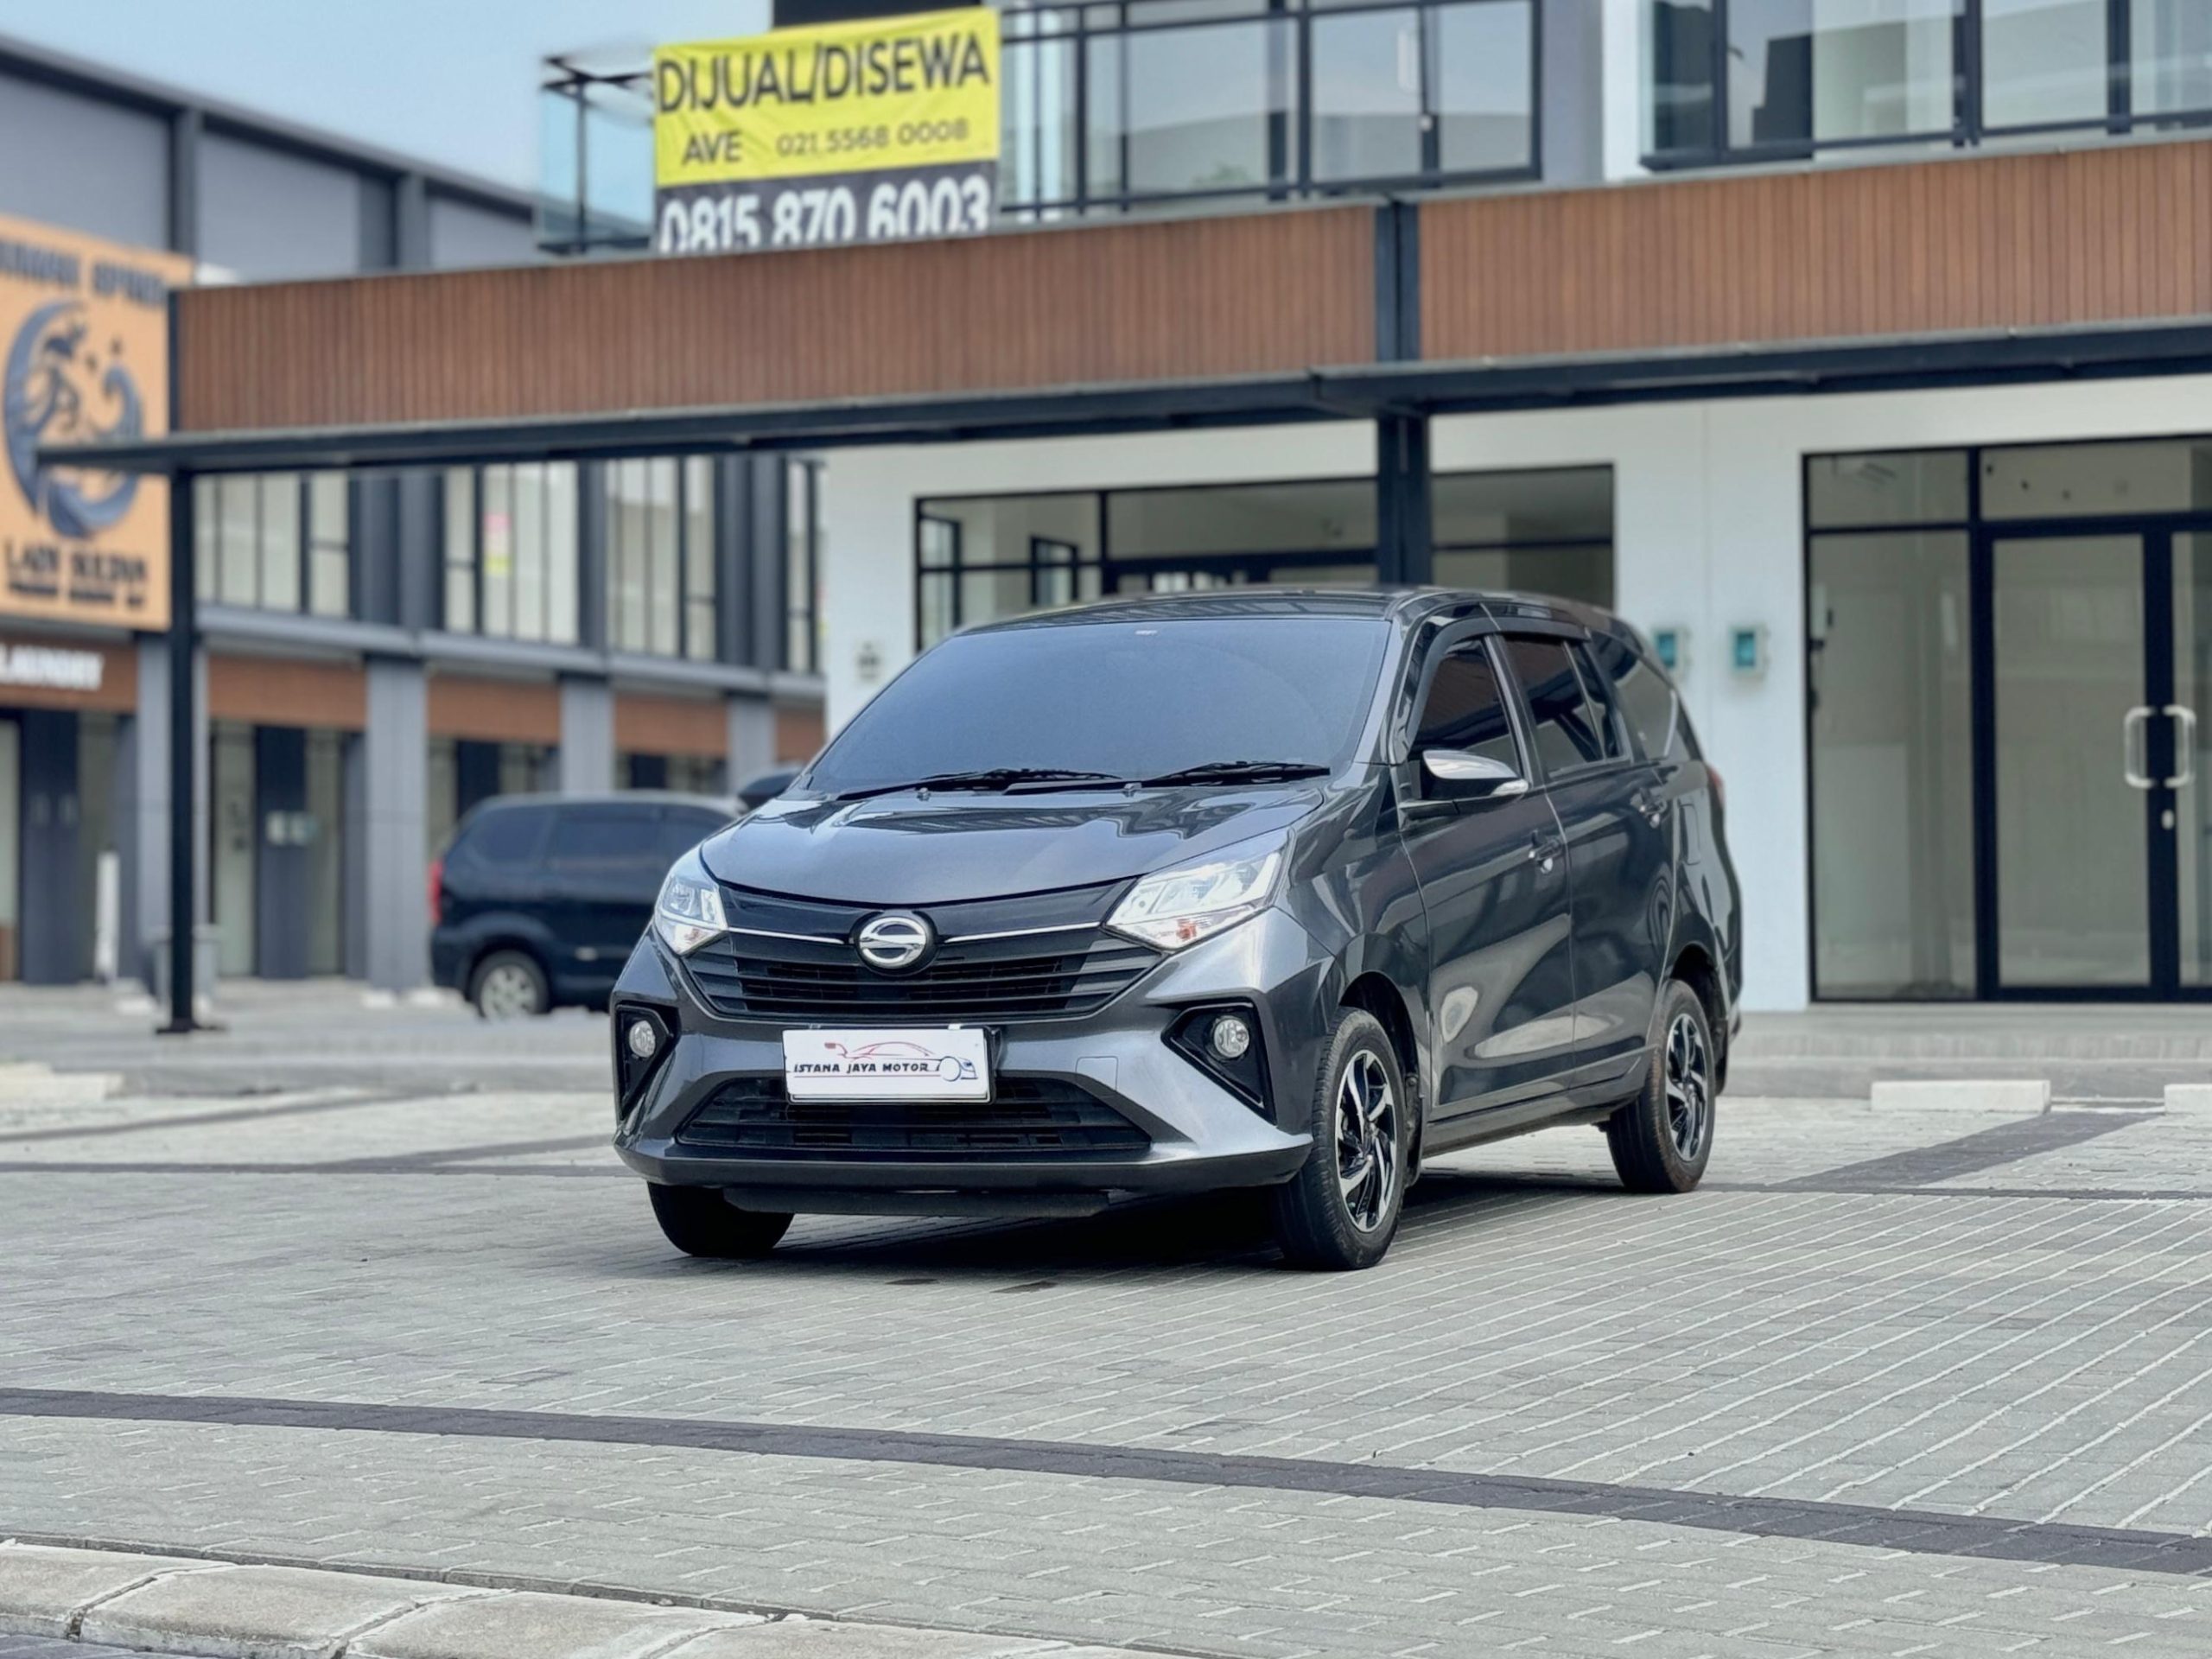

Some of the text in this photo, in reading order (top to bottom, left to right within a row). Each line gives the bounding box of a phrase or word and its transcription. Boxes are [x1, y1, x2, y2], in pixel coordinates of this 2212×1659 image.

[658, 30, 992, 115] DIJUAL/DISEWA
[682, 130, 743, 166] AVE
[825, 124, 891, 154] 5568
[896, 117, 969, 146] 0008
[659, 174, 989, 254] 0815 870 6003
[793, 1062, 929, 1074] ISTANA JAYA MOTOR
